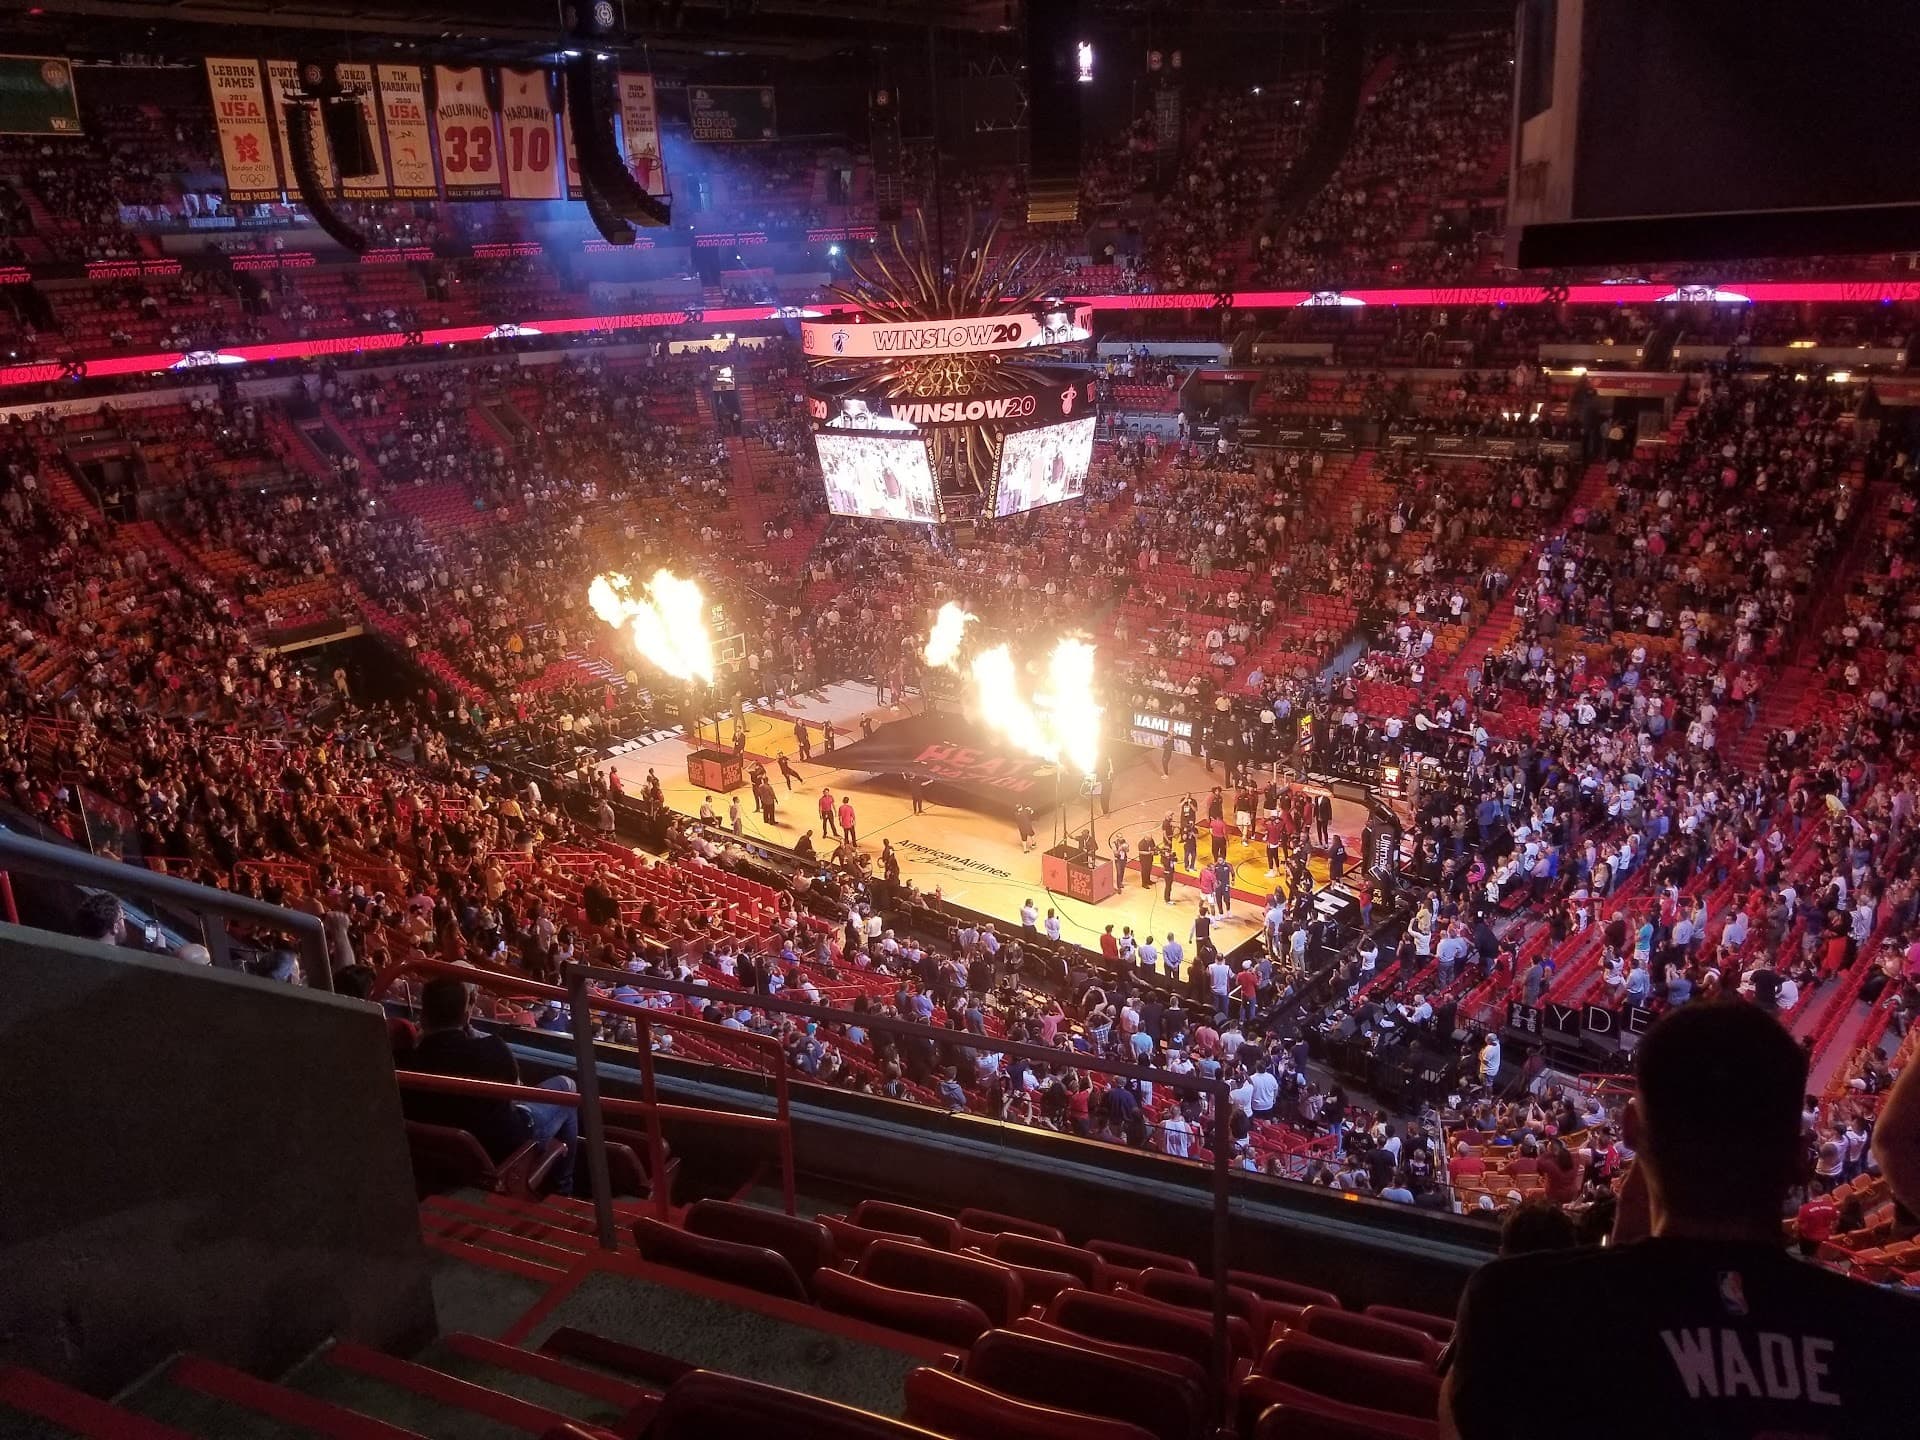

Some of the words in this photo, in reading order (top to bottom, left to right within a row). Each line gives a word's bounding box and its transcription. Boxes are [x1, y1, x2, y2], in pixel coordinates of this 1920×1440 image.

[211, 65, 256, 76] LEBRON
[342, 69, 366, 79] ONZO
[392, 71, 407, 81] TIM
[218, 78, 255, 88] JAMES
[381, 82, 421, 92] HARDAWAY
[219, 102, 261, 117] USA
[388, 105, 421, 118] USA
[439, 103, 489, 121] MOURNING
[504, 105, 549, 122] HARDAWAY
[444, 126, 492, 173] 33
[509, 126, 550, 172] 10
[230, 192, 251, 200] GOLD
[253, 191, 280, 200] MEDAL
[343, 190, 361, 198] GOLD
[394, 189, 412, 197] GOLD
[413, 189, 438, 197] MEDAL
[233, 259, 279, 271] MIAMI
[282, 258, 316, 268] HEAT
[360, 254, 401, 264] MIAMI
[404, 252, 434, 261] HEAT
[88, 267, 141, 280] MIAMI
[144, 264, 182, 276] HEAT
[913, 744, 1041, 777] HEAT
[895, 839, 1011, 878] AmericanAirlines
[1071, 870, 1091, 882] LET'S
[1071, 884, 1091, 897] HEAT
[1074, 879, 1087, 889] GO
[1511, 1003, 1651, 1034] HYDE
[1659, 1327, 1841, 1406] WADE
